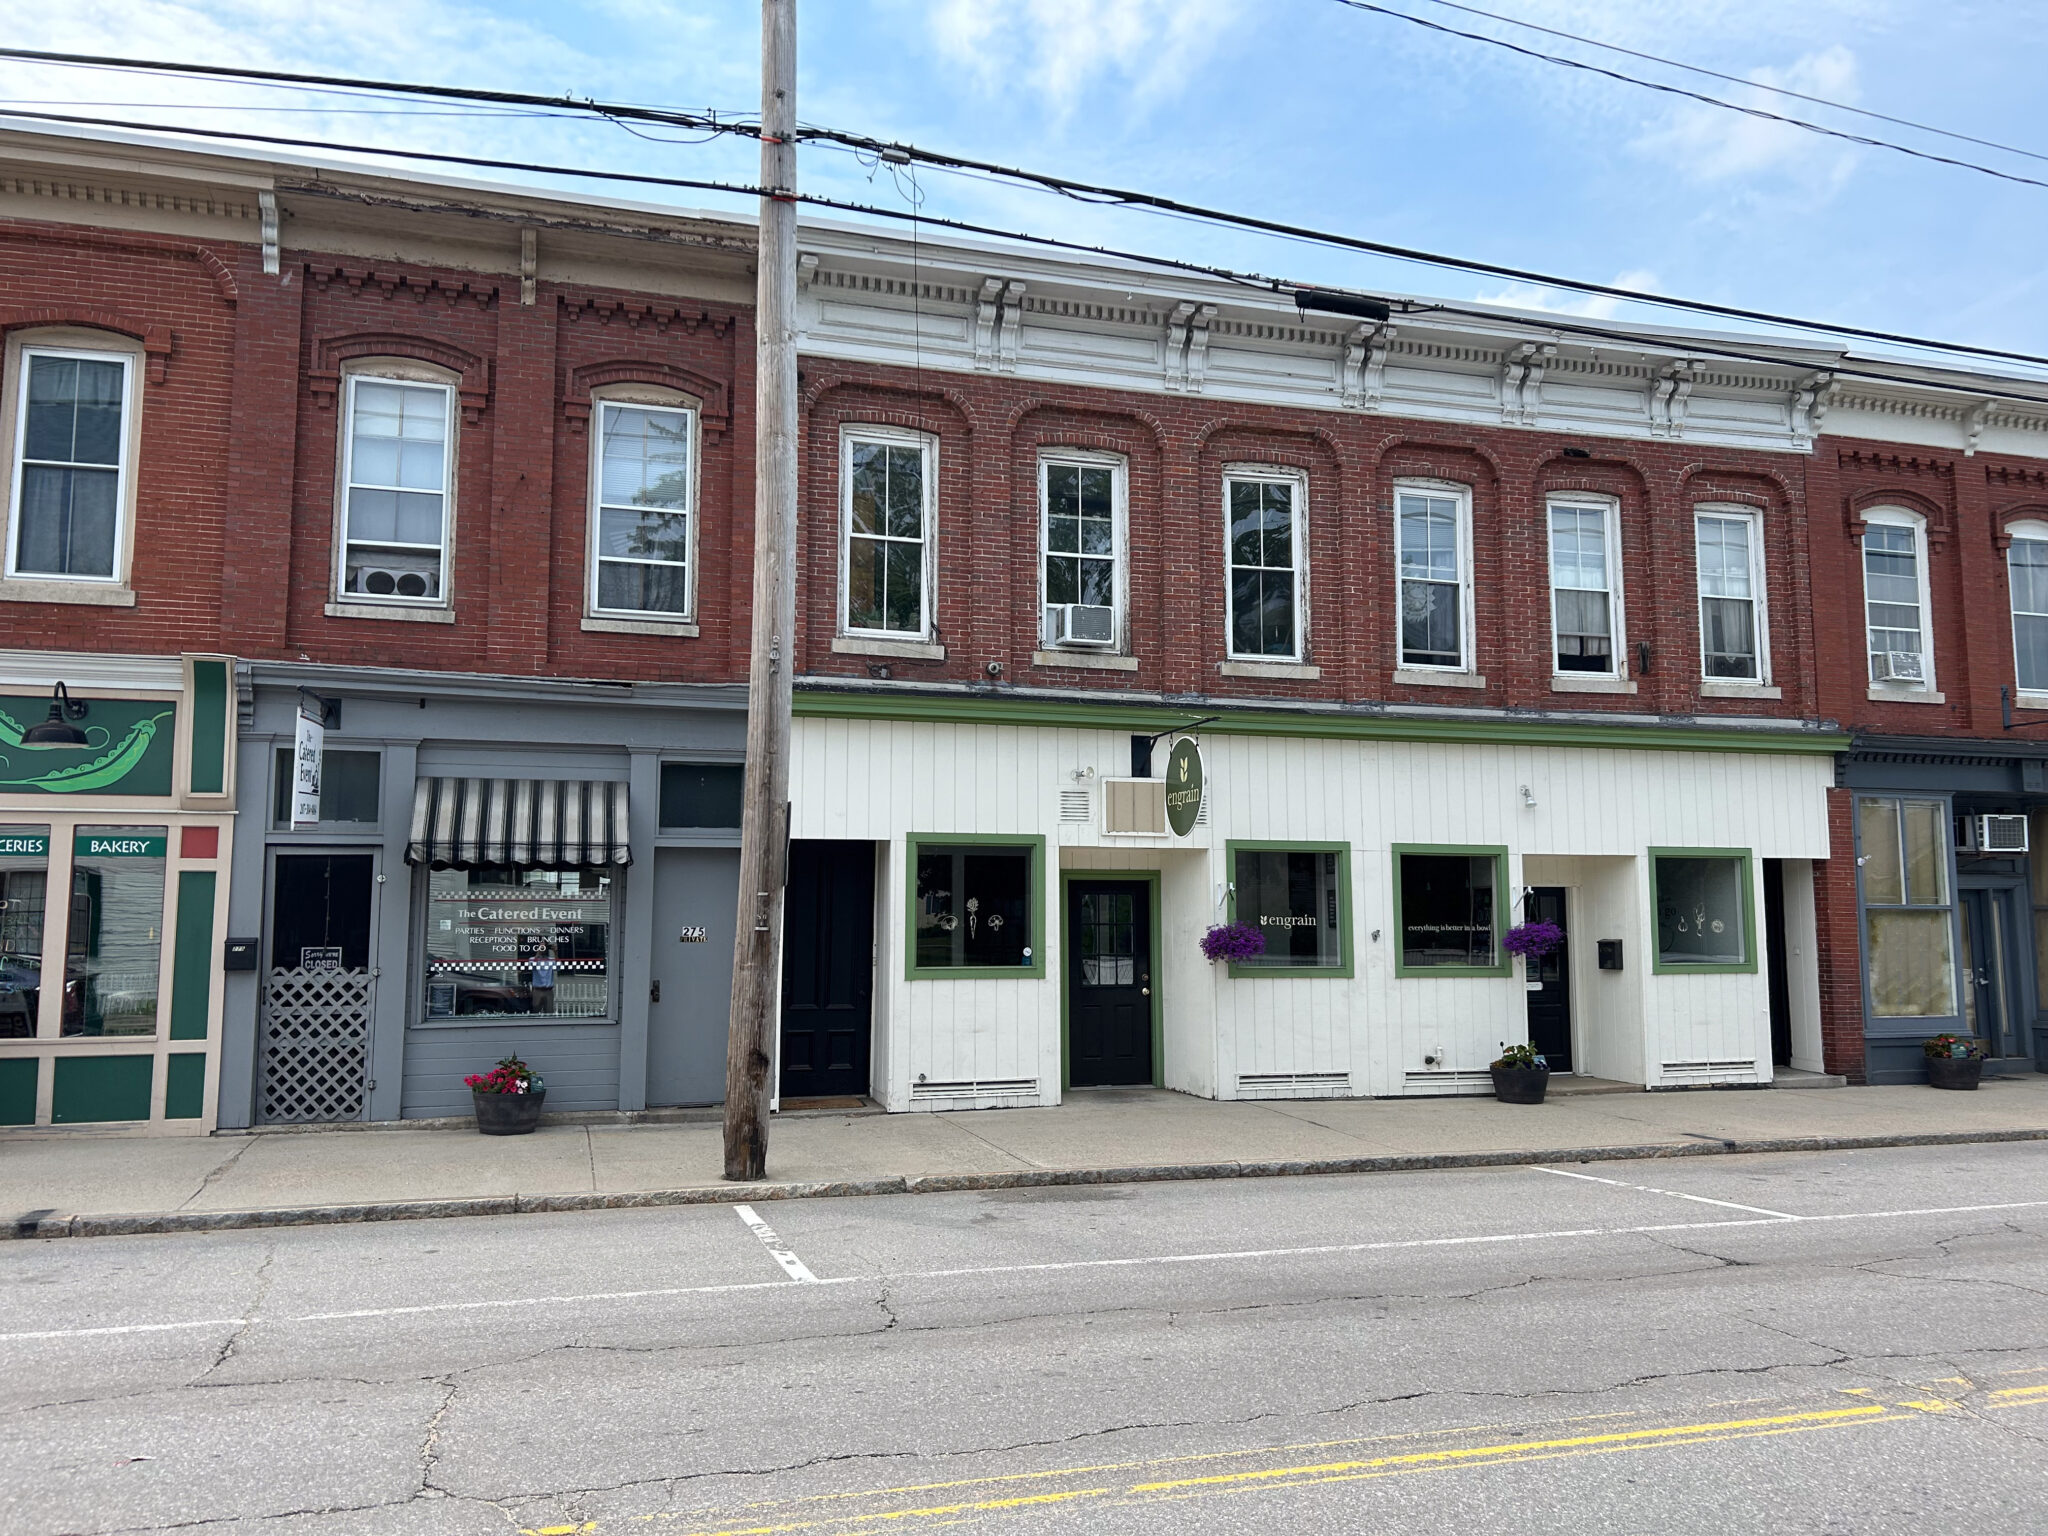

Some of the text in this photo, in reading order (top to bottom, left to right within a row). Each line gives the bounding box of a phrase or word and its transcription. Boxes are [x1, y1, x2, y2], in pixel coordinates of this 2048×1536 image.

[299, 741, 316, 763] Catered
[300, 763, 312, 783] Event
[1167, 785, 1199, 811] engrain
[90, 840, 150, 853] BAKERY
[458, 907, 583, 920] The Catered Event
[1269, 914, 1317, 930] engrain
[455, 927, 485, 935] PARTIES
[550, 926, 584, 934] DINNERS
[683, 927, 705, 937] 275
[1408, 924, 1440, 933] everything
[1445, 923, 1463, 931] better
[469, 936, 518, 944] RECEPTIONS
[492, 944, 547, 952] FOOD TO GO
[304, 960, 338, 969] CLOSED
